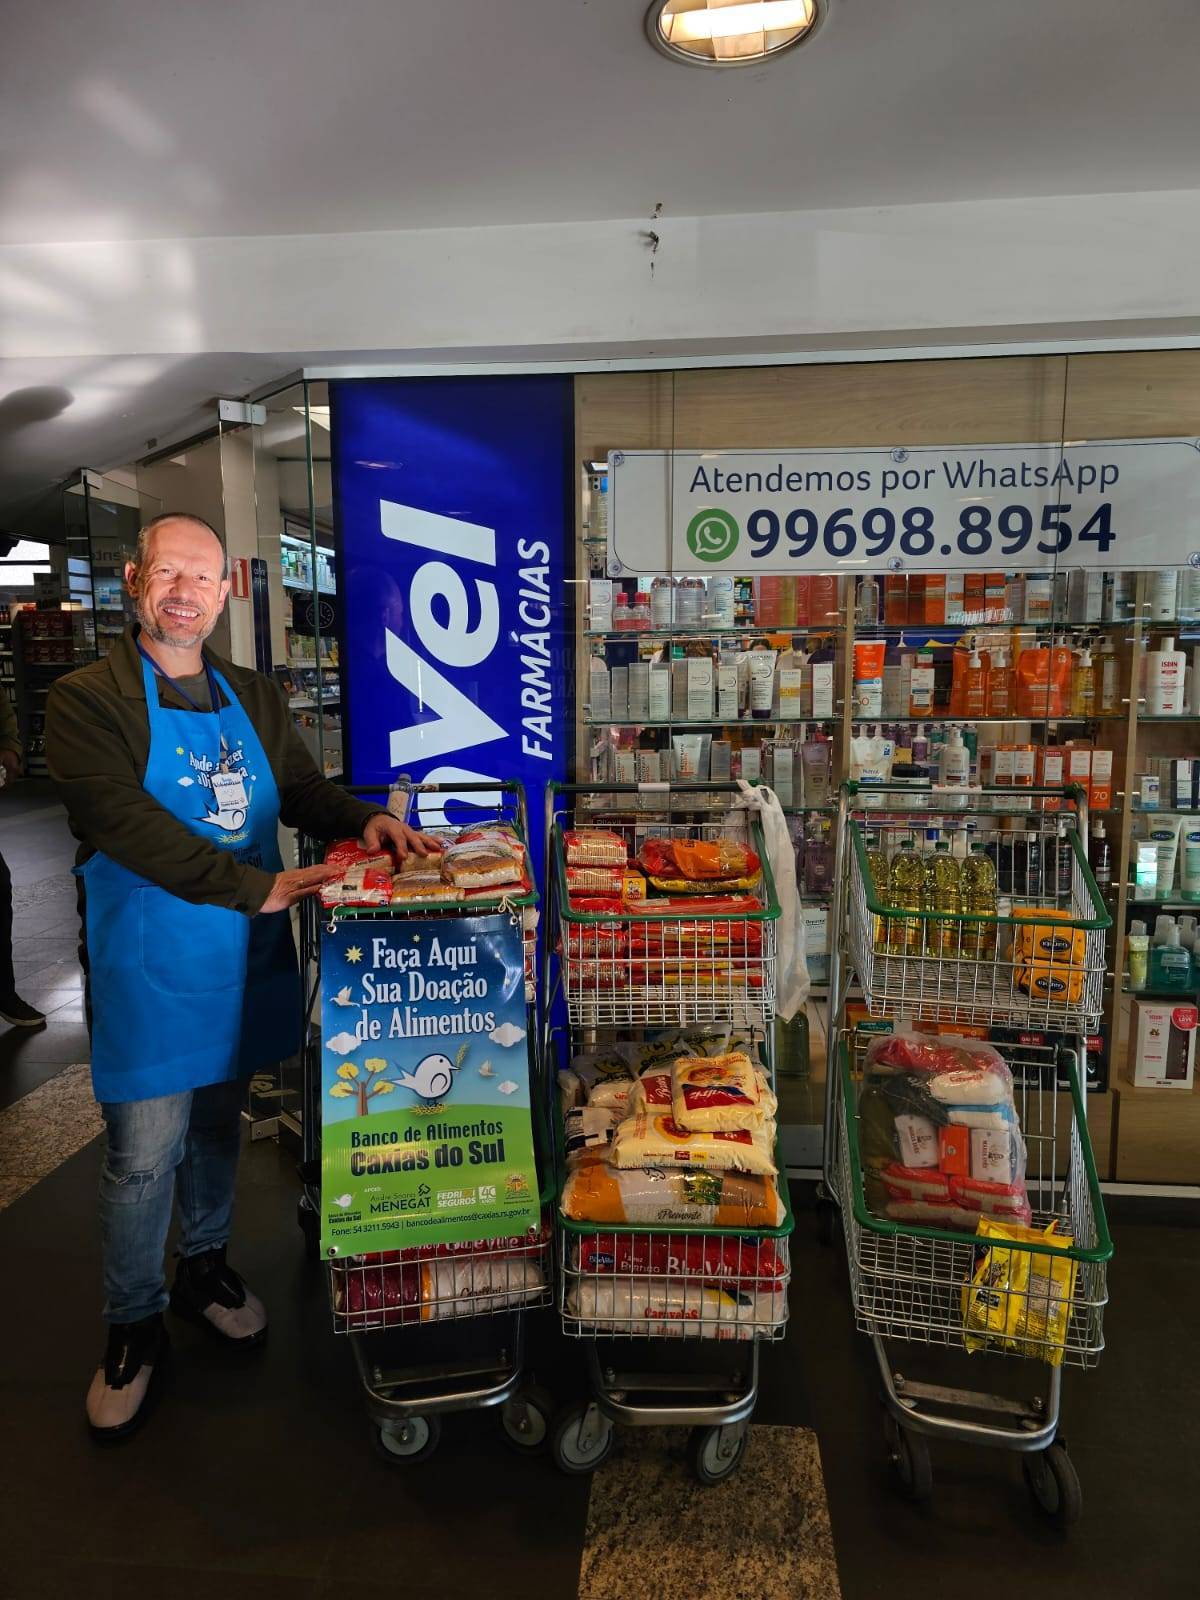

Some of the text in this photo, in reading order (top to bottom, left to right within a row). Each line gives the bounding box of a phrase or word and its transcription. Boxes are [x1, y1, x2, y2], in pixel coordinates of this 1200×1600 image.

[689, 458, 1120, 498] Atendemos por WhatsApp
[746, 503, 1117, 559] 99698.8954
[510, 537, 553, 761] FARMÁCIAS
[189, 751, 213, 772] Ajude
[371, 936, 478, 973] Faça Aqui
[362, 971, 488, 1005] Sua Doação
[355, 1007, 497, 1043] de Alimentos
[351, 1118, 504, 1149] Banco de Alimentos
[350, 1139, 506, 1177] Caxias do Sul
[370, 1196, 431, 1213] MENEGAT
[437, 1197, 476, 1208] SEGUROS
[332, 1227, 352, 1236] Fone:
